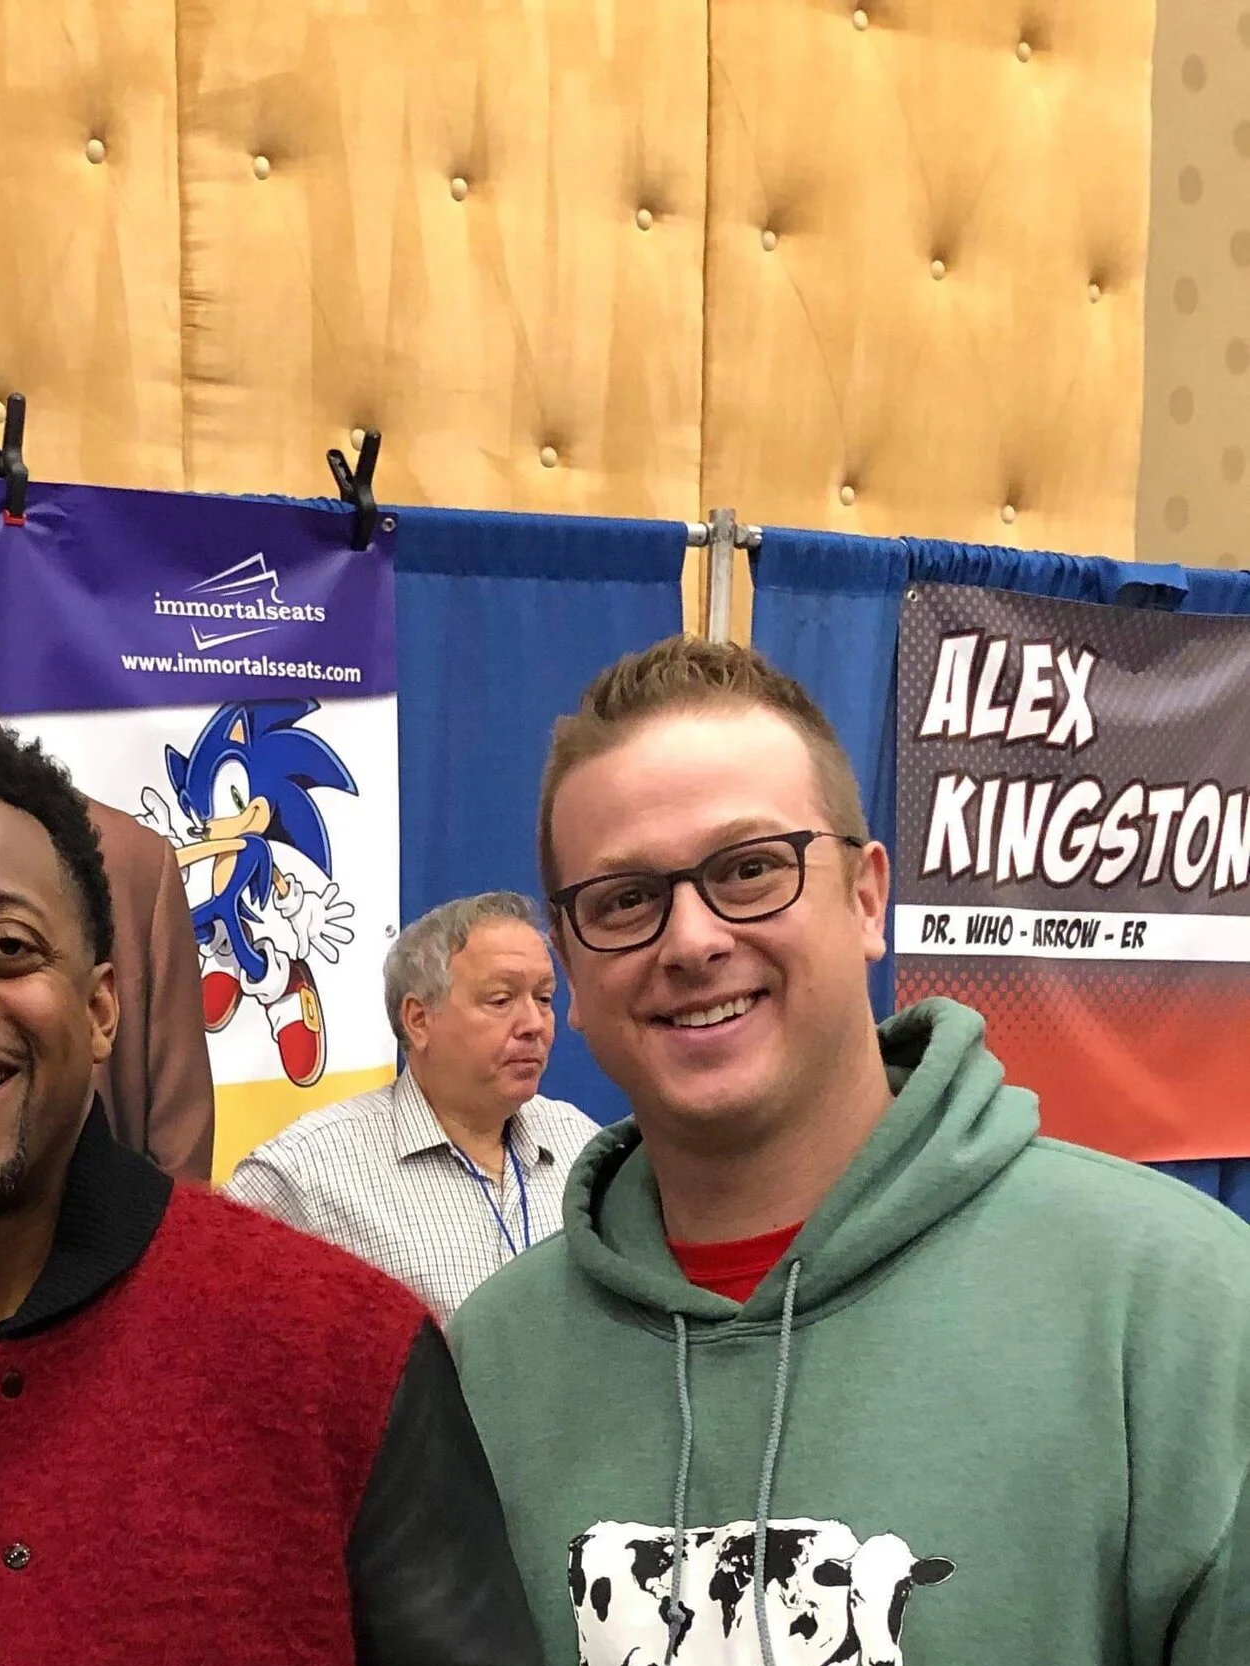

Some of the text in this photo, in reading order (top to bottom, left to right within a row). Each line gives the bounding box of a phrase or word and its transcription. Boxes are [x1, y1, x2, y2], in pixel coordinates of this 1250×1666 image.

[153, 591, 327, 623] immortalseats
[918, 632, 1101, 751] ALEX
[921, 772, 1250, 893] KINGSTON
[920, 913, 956, 945] DR.
[965, 913, 1014, 946] WHO
[1033, 917, 1103, 949] ARROW
[1121, 919, 1148, 950] ER
